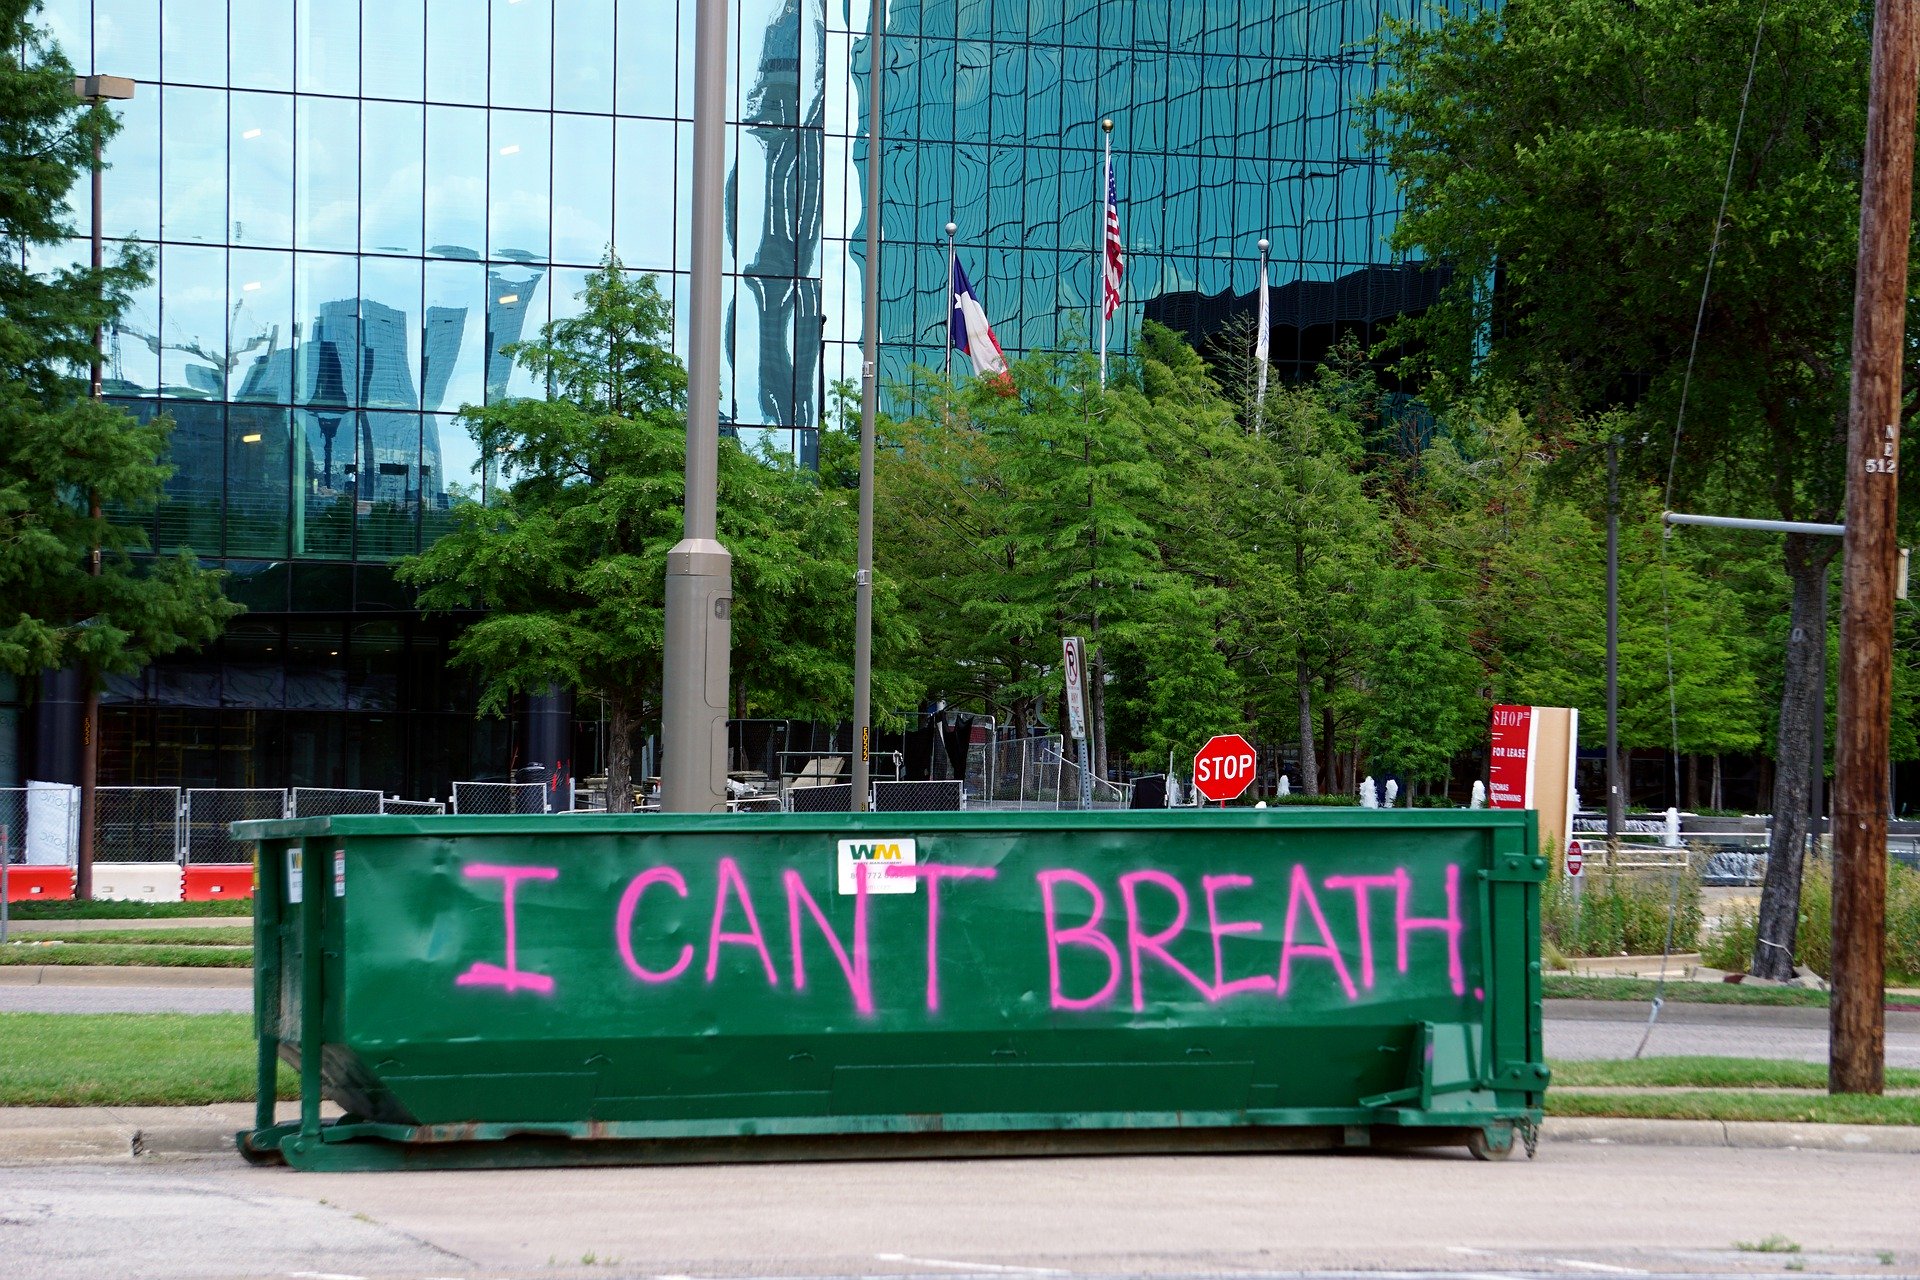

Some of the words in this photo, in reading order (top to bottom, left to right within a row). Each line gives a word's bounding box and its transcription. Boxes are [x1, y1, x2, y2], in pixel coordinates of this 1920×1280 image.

[1865, 458, 1896, 473] 512
[1493, 710, 1523, 726] SHOP
[1492, 747, 1505, 757] FOR
[1506, 748, 1526, 758] LEASE
[1198, 754, 1252, 782] STOP
[850, 844, 901, 860] WM
[455, 863, 559, 993] I
